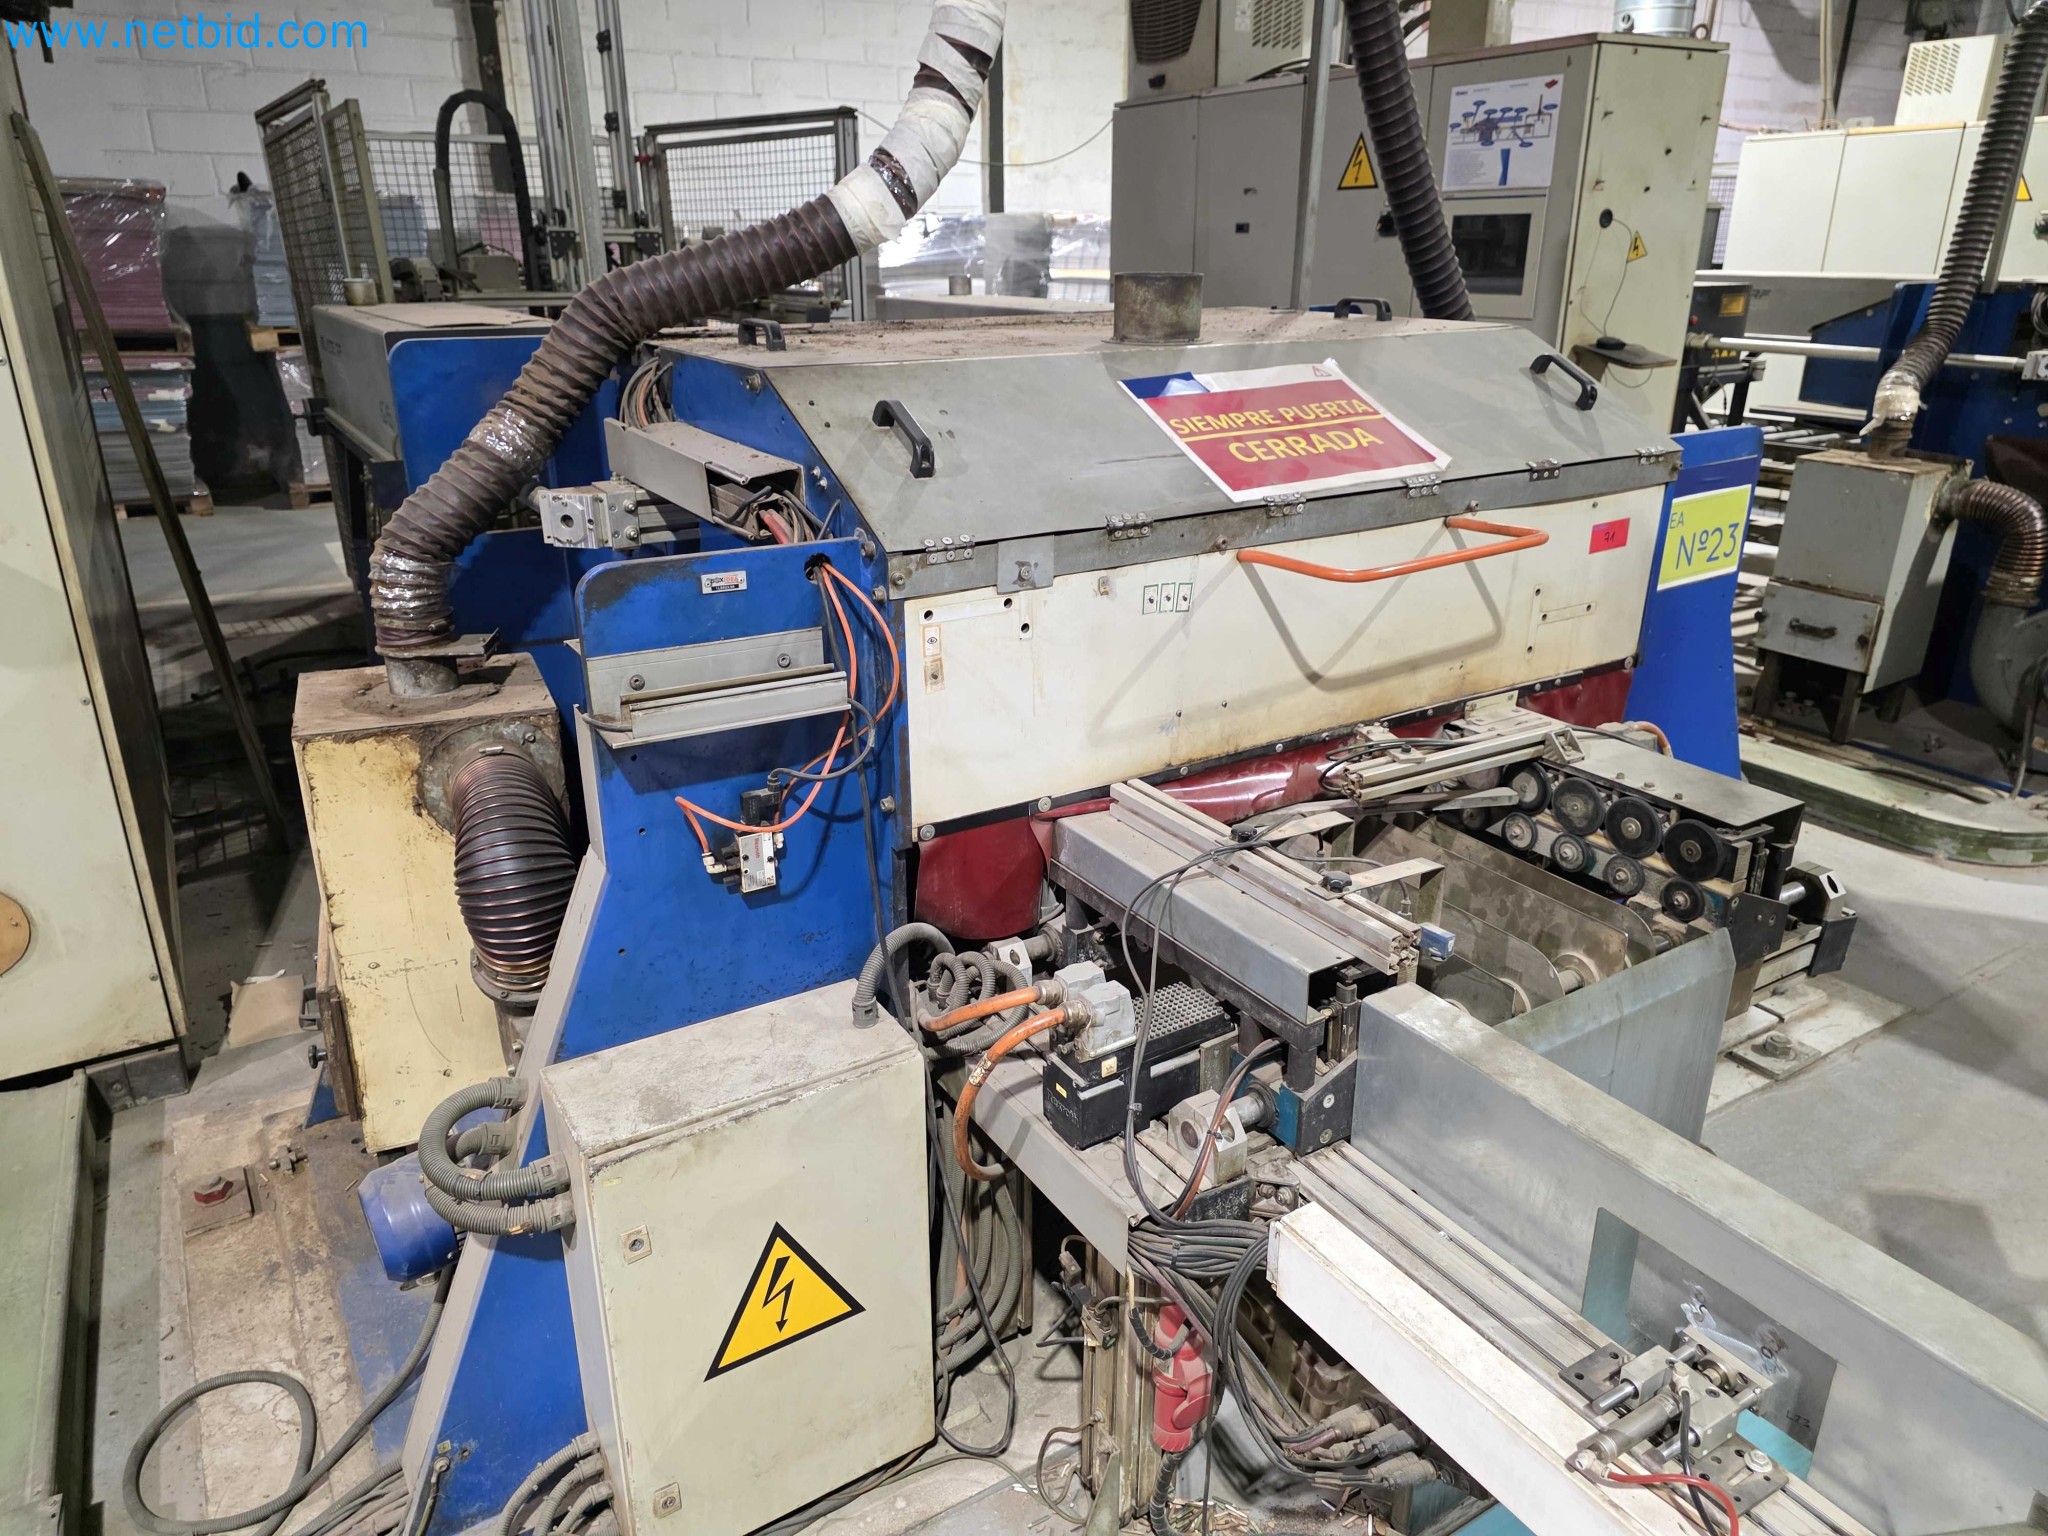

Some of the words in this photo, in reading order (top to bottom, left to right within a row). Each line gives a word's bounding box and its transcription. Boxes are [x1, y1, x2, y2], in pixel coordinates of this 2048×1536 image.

[1168, 408, 1280, 436] SIEMPRE
[1276, 397, 1374, 424] PUERTA
[1228, 426, 1385, 464] CERRADA
[1669, 511, 1685, 530] EA
